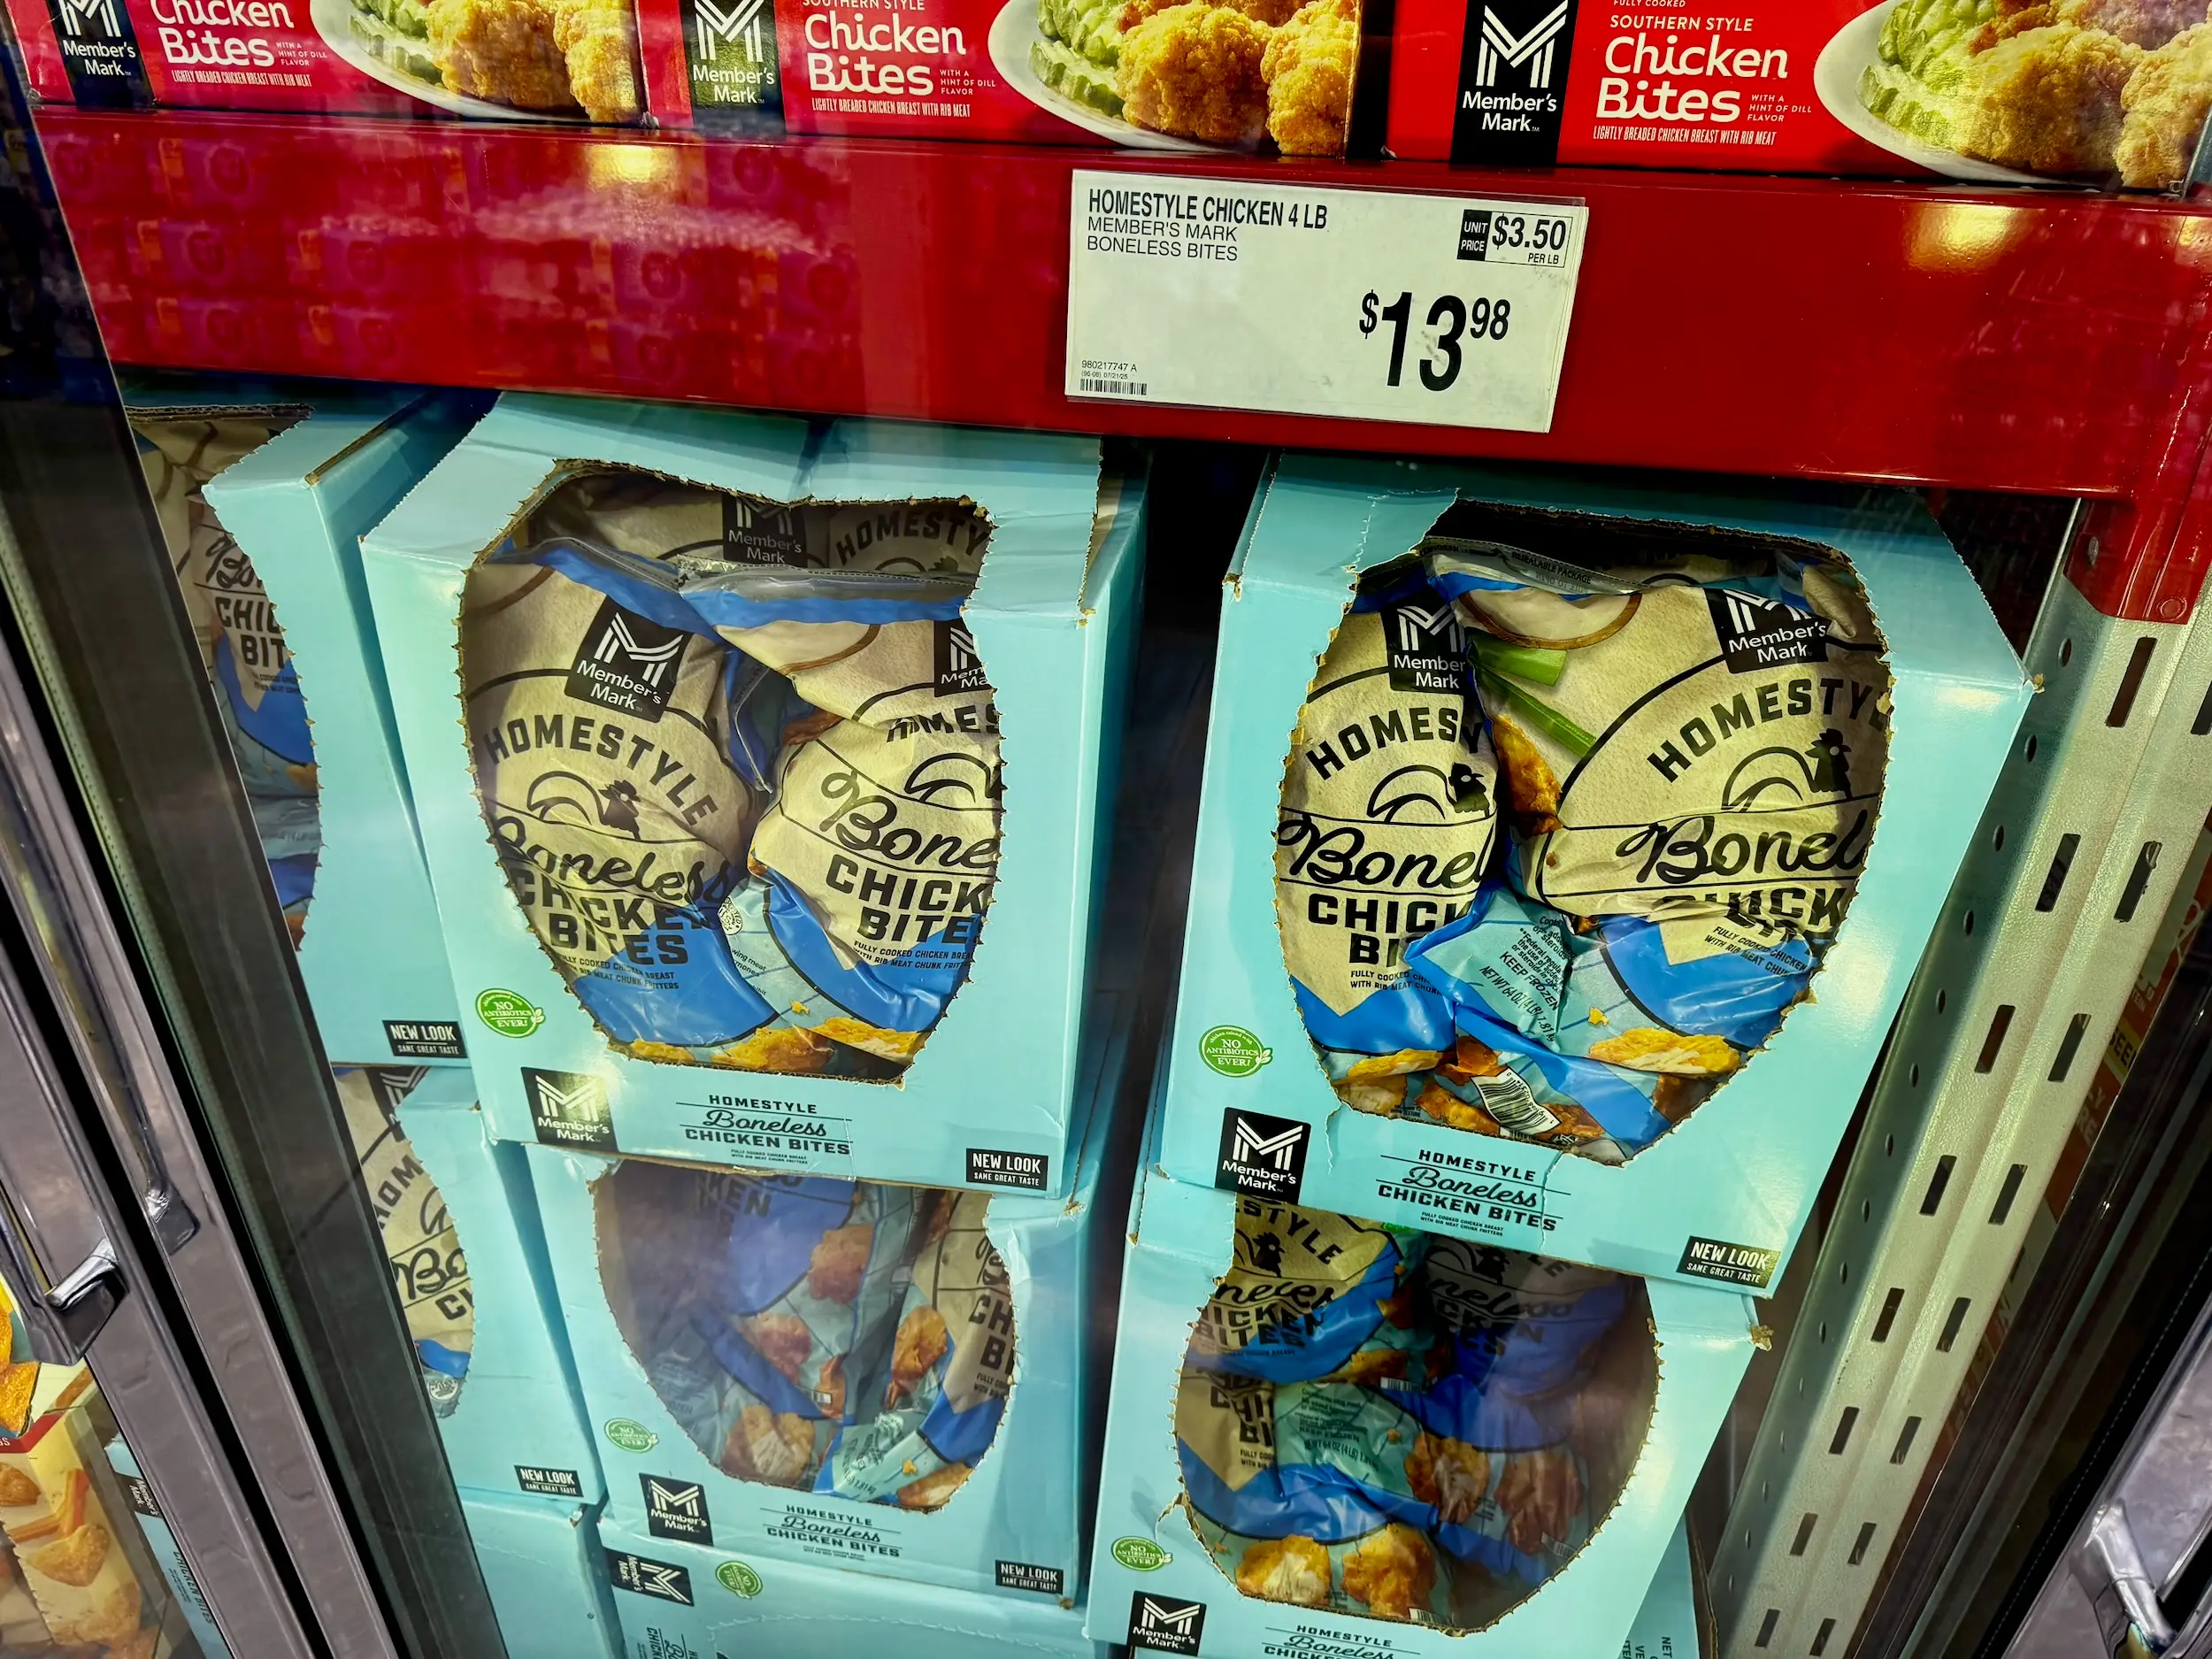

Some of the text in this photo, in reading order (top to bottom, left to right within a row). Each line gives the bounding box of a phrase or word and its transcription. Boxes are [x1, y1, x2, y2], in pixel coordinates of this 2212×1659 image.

[150, 0, 295, 28] Chicken
[885, 0, 926, 11] STYLE
[804, 11, 966, 55] Chicken
[1609, 15, 1754, 32] SOUTHERN STYLE
[62, 40, 136, 58] Member's
[157, 27, 275, 66] Bites
[1604, 32, 1788, 79] Chicken
[84, 59, 126, 76] Mark
[171, 70, 269, 85] LIGHTLY CHICKEN BREAST
[692, 64, 775, 85] Member's
[807, 52, 933, 96] Bites
[714, 84, 758, 104] Mark
[1462, 90, 1557, 112] Member's
[1595, 77, 1741, 123] Bites
[811, 97, 971, 118] LIGHTLY BREADED CHICKEN BREAST WITH RIB MEAT
[1747, 113, 1785, 122] FLAVOR
[1482, 112, 1532, 133] Mark
[1593, 126, 1777, 146] LIGHTLY BREADED CHICKEN BREAST WITH RIB MEAT
[1088, 188, 1328, 229] HOMESTYLE CHICKEN 4 LB
[1087, 217, 1238, 242] MEMBER'S MARK
[1463, 221, 1488, 234] UNIT
[1492, 212, 1566, 250] $3.50
[1087, 235, 1238, 261] BONELESS BITES
[1461, 240, 1485, 251] PRICE
[1528, 253, 1559, 264] PER LB
[1081, 359, 1129, 371] 980217747
[728, 529, 802, 554] Member's
[746, 548, 786, 565] Mark
[1557, 567, 1592, 585] PACKAGE
[1728, 622, 1826, 654] Member's
[1756, 641, 1808, 664] Mark
[576, 659, 662, 705] Member's
[1416, 672, 1460, 689] Mark
[590, 682, 637, 710] Mark
[483, 713, 718, 826] HOMESTYLE
[1704, 934, 1727, 948] WITH
[1713, 926, 1739, 940] FULLY
[854, 941, 949, 959] FULLY COOKED CHICKEN
[1517, 938, 1540, 962] the use
[580, 958, 611, 970] COOKED
[732, 949, 767, 972] wing meat
[915, 961, 941, 970] CHUNK
[1518, 950, 1542, 976] steroids
[1378, 972, 1409, 981] COOKED
[1479, 965, 1497, 980] NET
[1495, 976, 1509, 992] WT
[1503, 986, 1515, 998] 64
[1500, 950, 1528, 978] KEEP
[1524, 974, 1558, 1011] FROZEN
[493, 1001, 514, 1010] NO
[390, 1025, 457, 1041] NEW LOOK
[417, 1045, 438, 1054] GREAT
[439, 1046, 459, 1055] TASTE
[1206, 1047, 1259, 1056] ANTIBIOTICS
[1221, 1039, 1241, 1048] NO
[1217, 1057, 1251, 1066] EVER!
[709, 1094, 818, 1115] HOMESTYLE
[537, 1116, 611, 1134] Member's
[702, 1109, 828, 1137] Boneless
[557, 1129, 596, 1142] Mark
[685, 1128, 851, 1156] CHICKEN BITES
[972, 1153, 1041, 1174] NEW LOOK
[1222, 1160, 1297, 1185] Member's
[1417, 1149, 1536, 1182] HOMESTYLE
[995, 1173, 1017, 1183] GREAT
[1018, 1176, 1040, 1186] TASTE
[1238, 1174, 1277, 1192] Mark
[1402, 1166, 1538, 1208] Boneless
[1378, 1184, 1557, 1231] CHICKEN BITES
[1690, 1241, 1770, 1270] NEW LOOK
[1686, 1262, 1761, 1284] SAME GREAT TASTE
[519, 1468, 575, 1485] NEW LOOK
[649, 1508, 708, 1527] Member's
[786, 1504, 873, 1526] HOMESTYLE
[664, 1519, 695, 1532] Mark
[780, 1515, 882, 1543] Boneless
[767, 1527, 843, 1548] CHICKEN
[849, 1540, 901, 1557] BITES
[1130, 1544, 1146, 1554] NO
[1125, 1555, 1156, 1564] EVER!
[1001, 1563, 1058, 1582] NEW LOOK
[1019, 1578, 1038, 1588] GREAT
[1133, 1625, 1196, 1645] Member's
[1146, 1636, 1179, 1649] Mark
[1296, 1624, 1393, 1647] HOMESTYLE
[1661, 1636, 1673, 1658] NET
